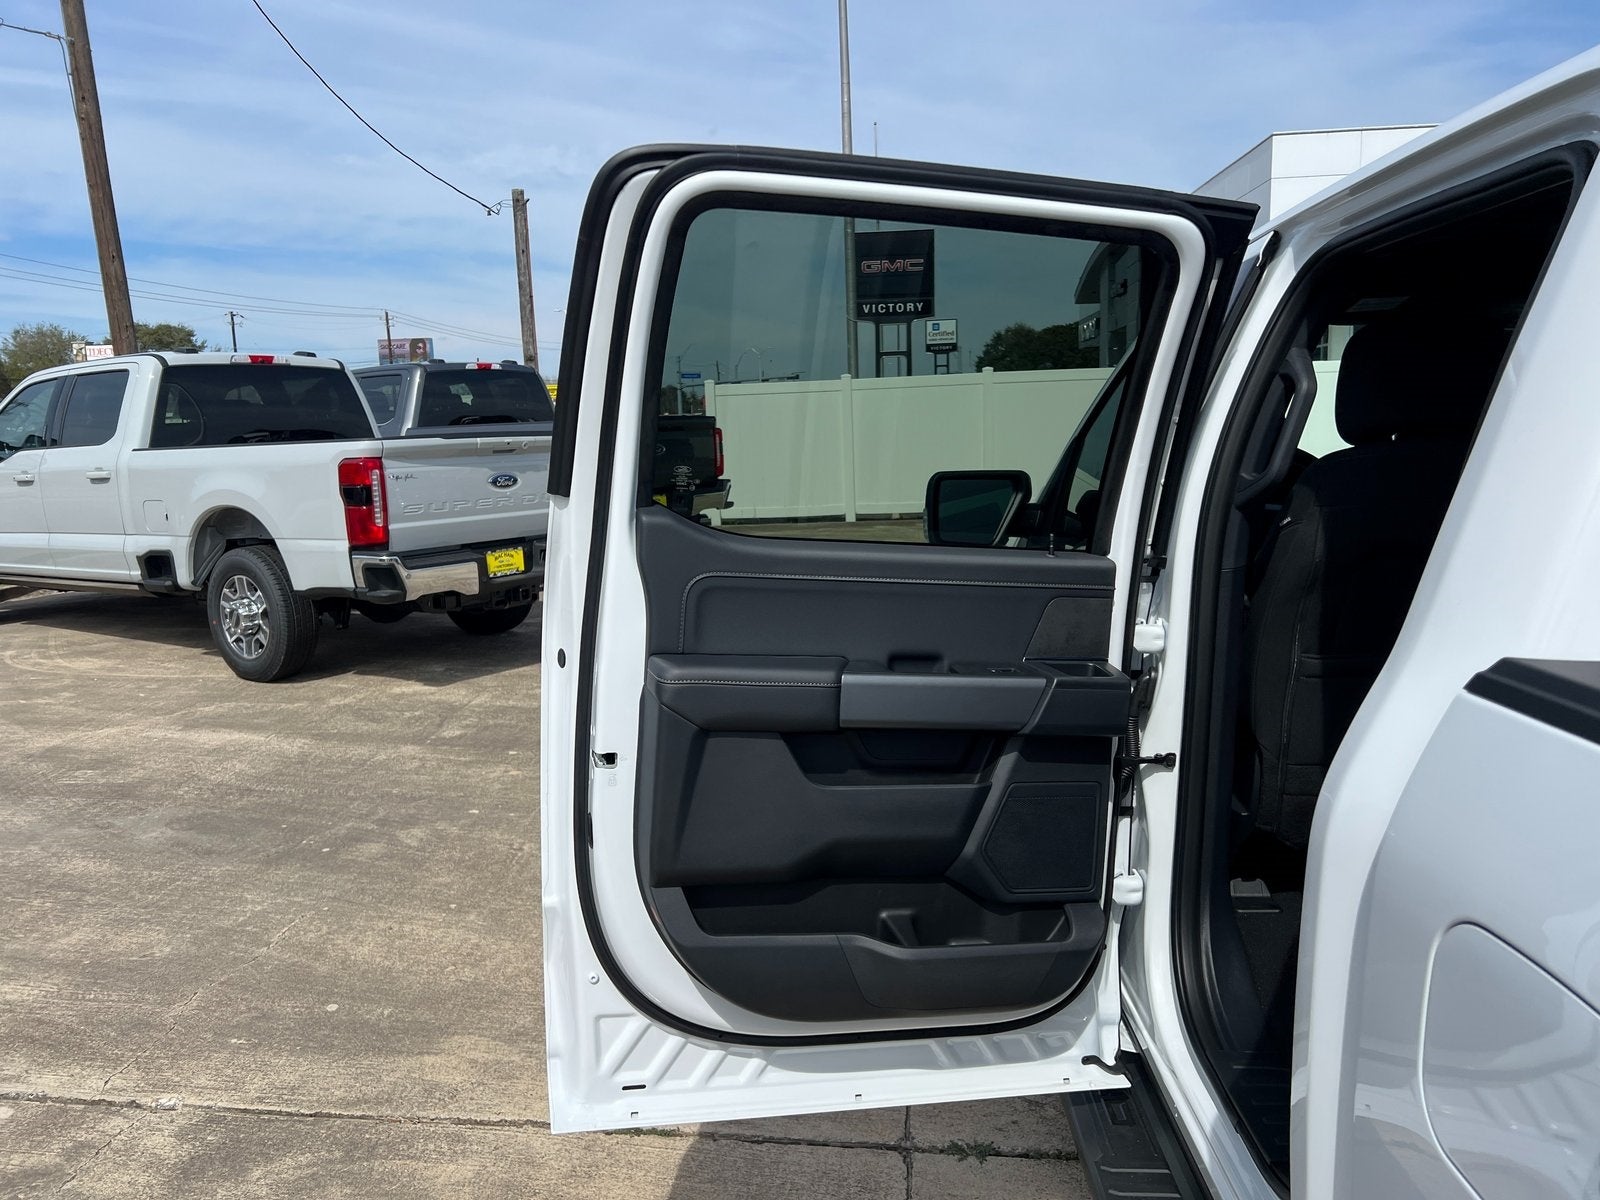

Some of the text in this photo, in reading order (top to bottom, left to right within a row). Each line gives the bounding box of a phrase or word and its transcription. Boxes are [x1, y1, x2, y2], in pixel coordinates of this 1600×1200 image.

[861, 259, 924, 273] GMC
[863, 302, 924, 314] VICTORY
[496, 476, 513, 486] Ford
[403, 497, 514, 516] SUPER
